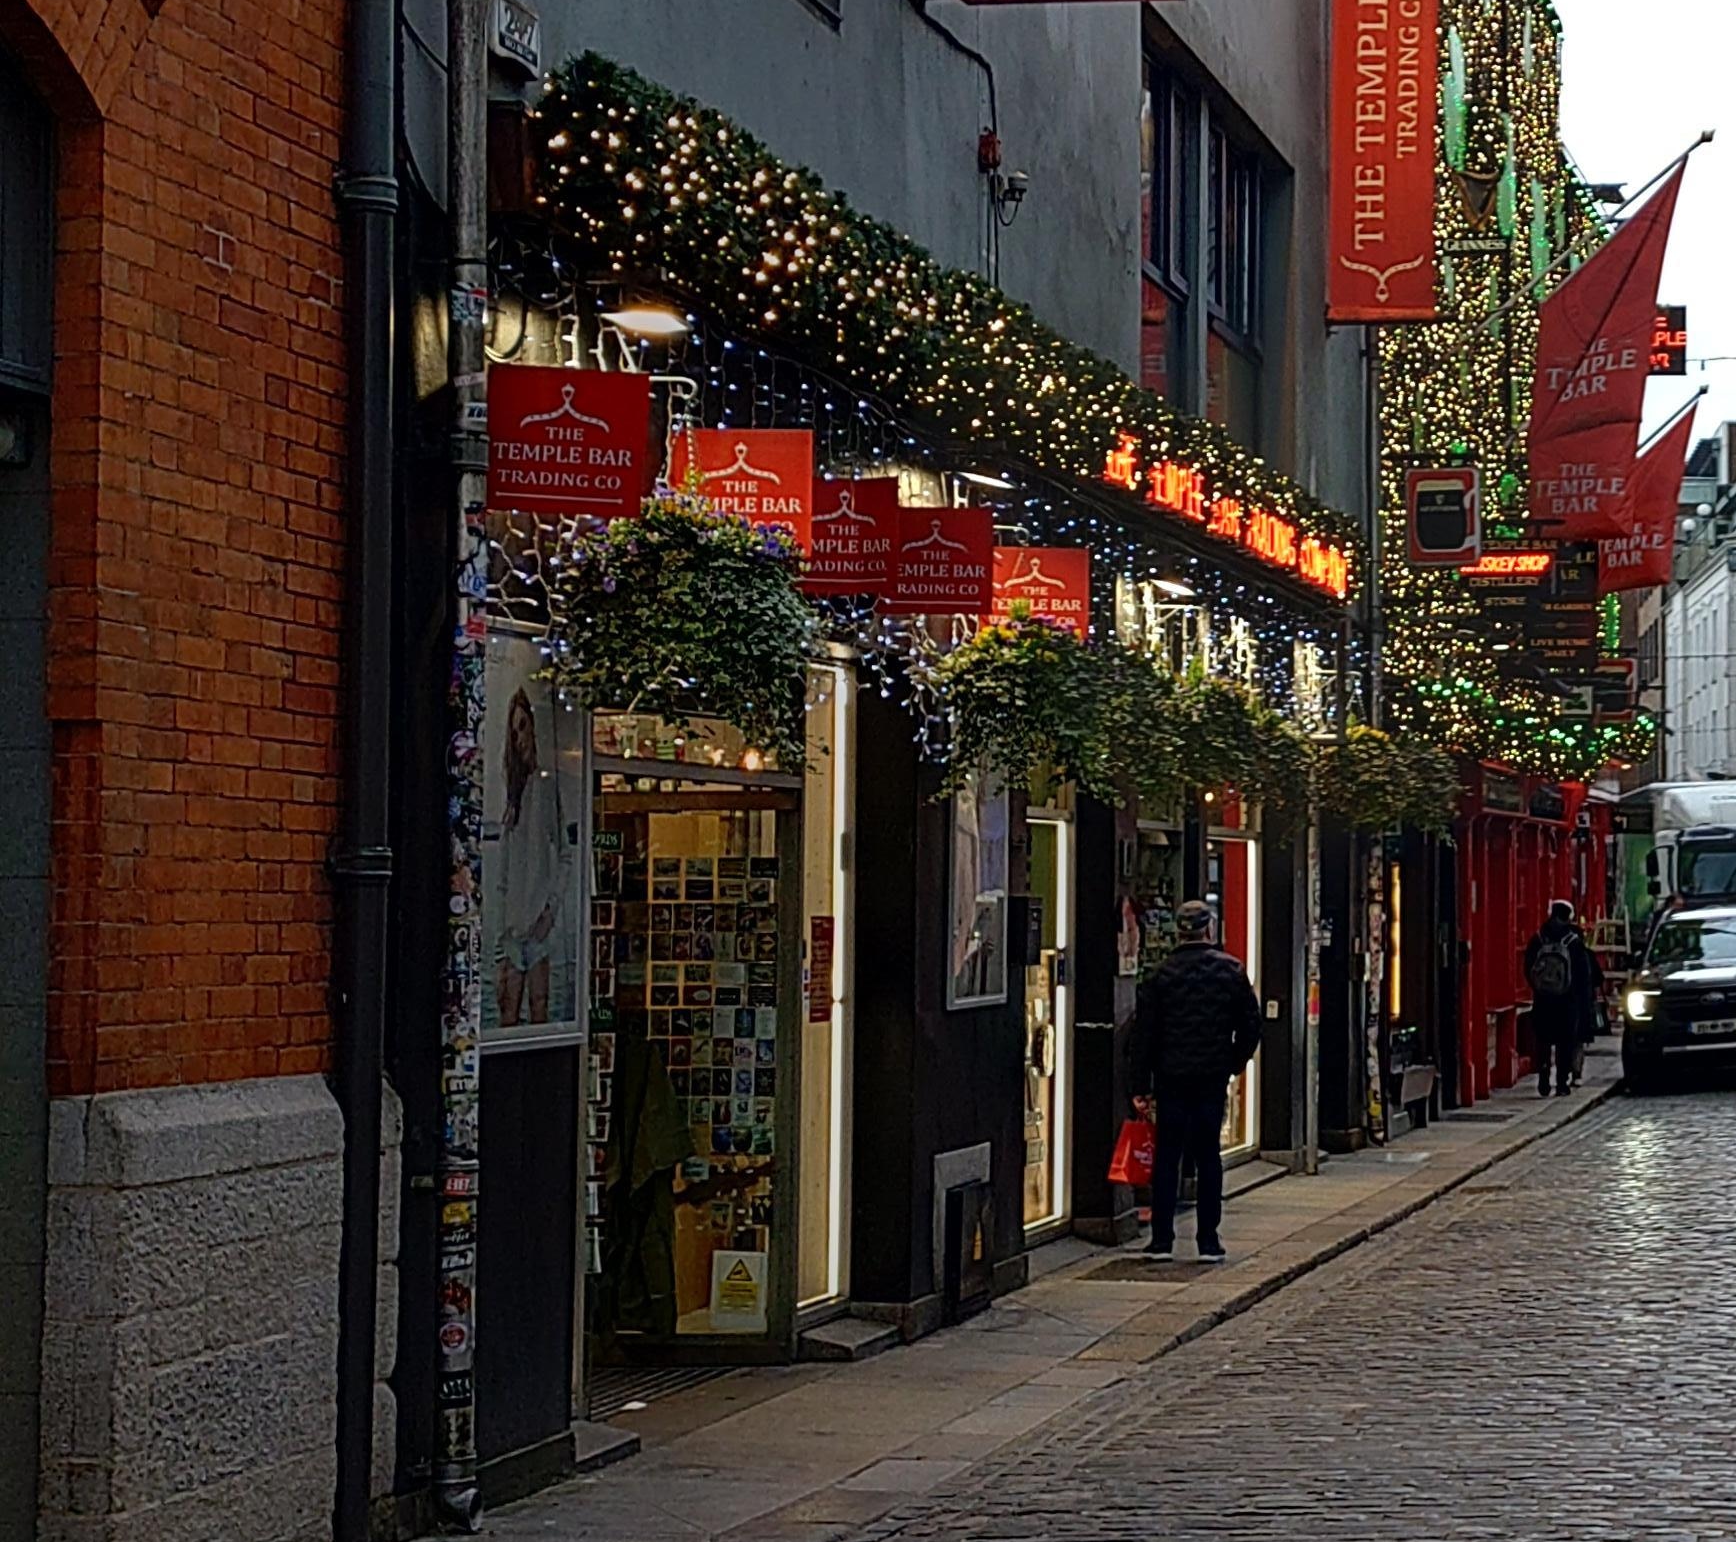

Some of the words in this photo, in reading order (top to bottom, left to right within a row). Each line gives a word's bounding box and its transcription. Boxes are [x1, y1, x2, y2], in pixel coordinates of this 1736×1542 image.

[1395, 23, 1420, 159] TRADING
[1354, 164, 1385, 251] THE
[1443, 239, 1507, 251] GUINNESS
[1650, 330, 1687, 347] PLE
[1545, 348, 1638, 390] TMPLE
[545, 426, 584, 441] THE
[493, 442, 582, 464] TEMPLE
[588, 447, 632, 467] BAR
[1560, 463, 1597, 477] THE
[497, 469, 589, 488] TRADING
[594, 475, 621, 490] CO
[722, 480, 758, 493] THE
[1534, 477, 1626, 497] TEMPLE
[711, 497, 757, 513] MPLE
[762, 497, 802, 514] BAR
[1552, 496, 1599, 514] BAR
[828, 524, 860, 537] THE
[811, 539, 858, 554] MPLE
[863, 538, 891, 554] BAR
[920, 550, 950, 561] THE
[1607, 551, 1645, 568] BAR
[811, 560, 865, 573] ADING
[1515, 555, 1550, 572] SHOP
[897, 564, 950, 578] EMPLE
[953, 565, 986, 578] BAR
[897, 583, 956, 595] RADING
[959, 584, 979, 595] CO
[1469, 577, 1541, 587] DISTILLERY
[1021, 586, 1049, 596] THE
[1051, 599, 1082, 612] BAR
[1484, 597, 1528, 606] STORE
[1530, 638, 1556, 647] LIVE
